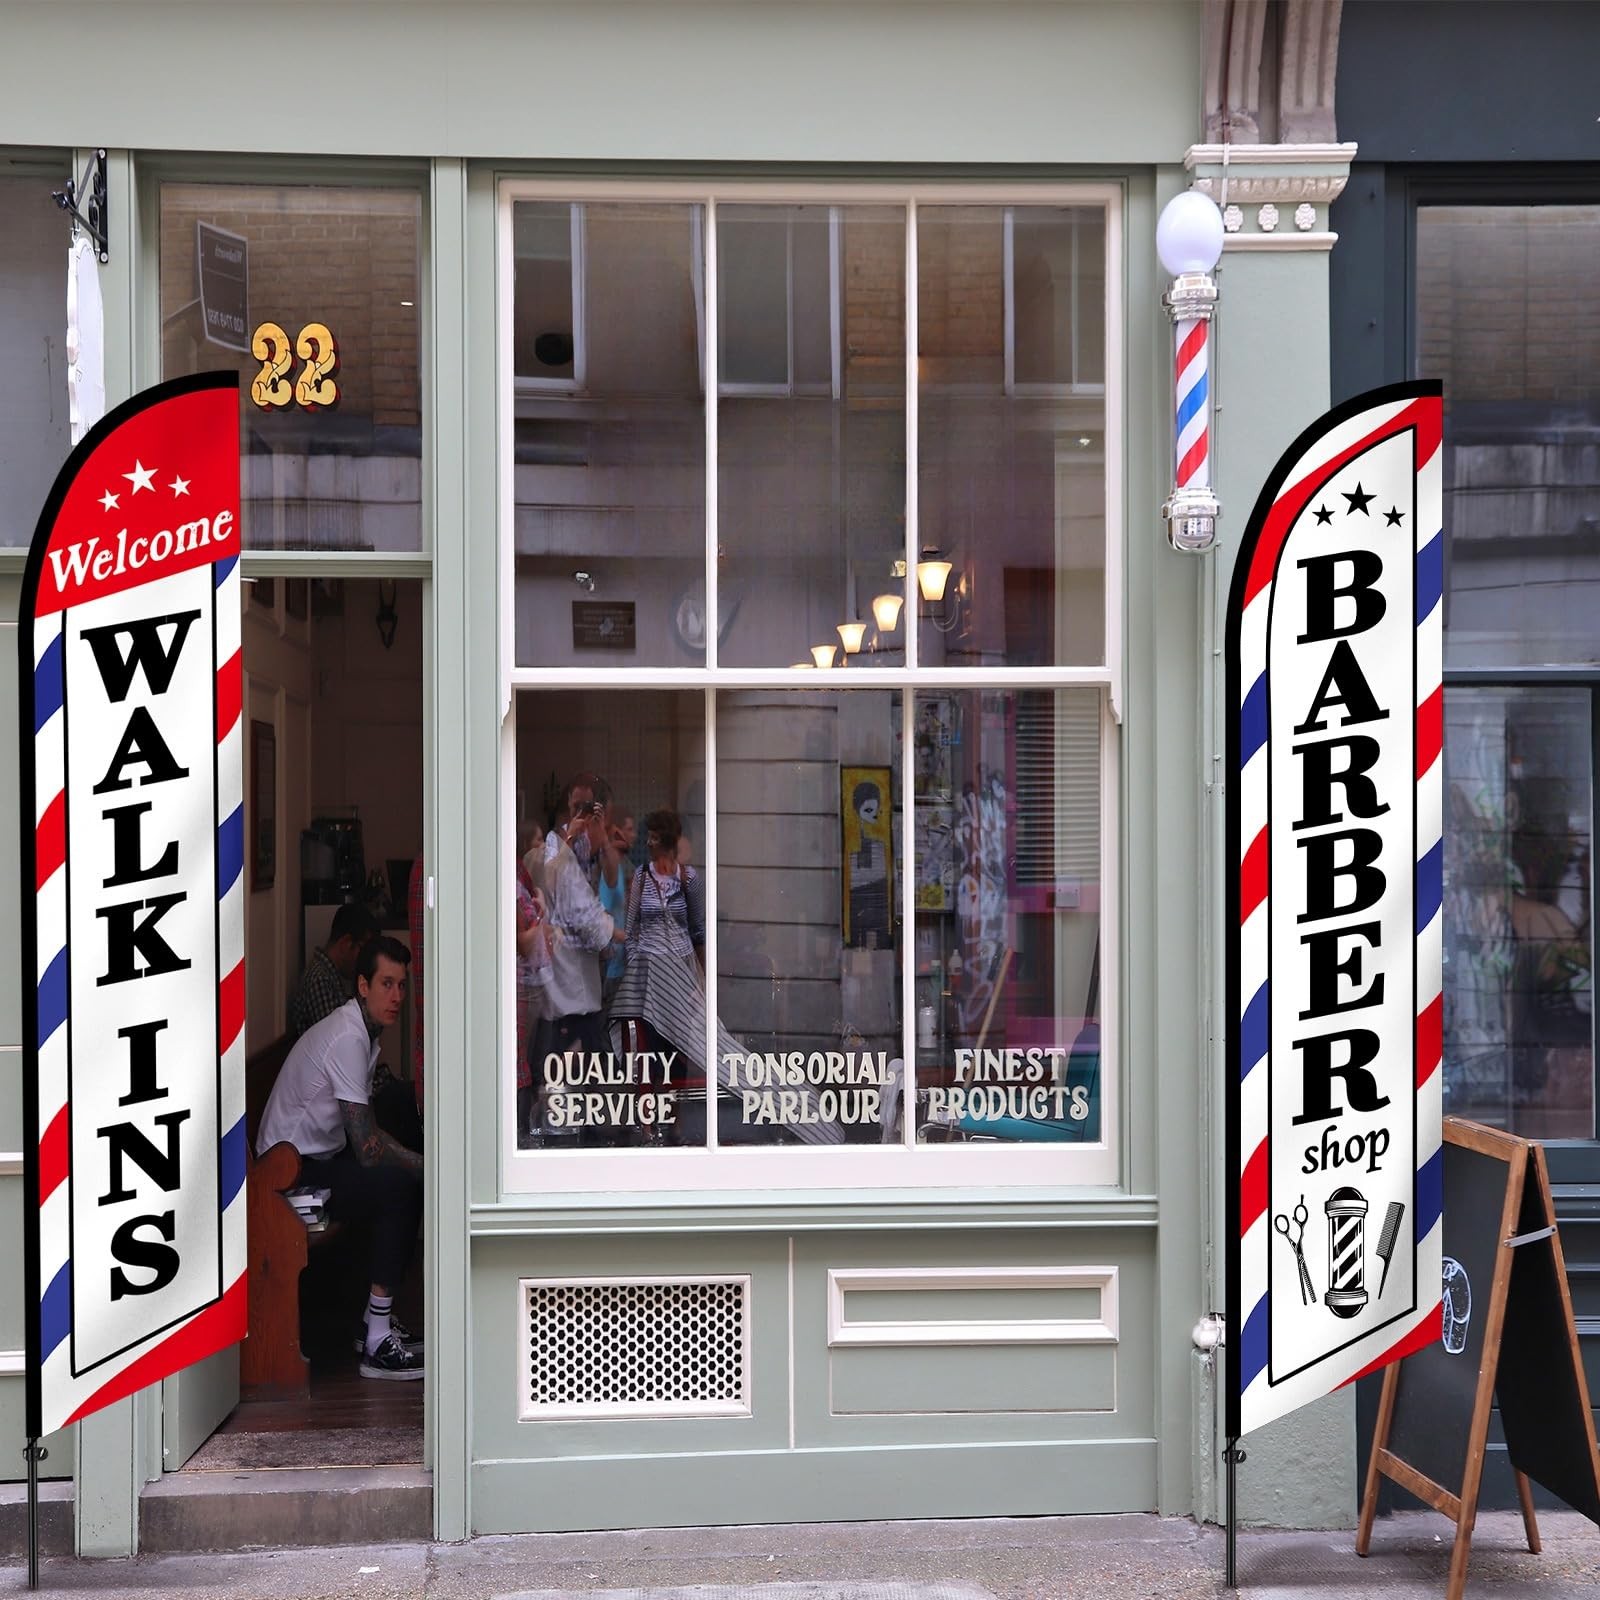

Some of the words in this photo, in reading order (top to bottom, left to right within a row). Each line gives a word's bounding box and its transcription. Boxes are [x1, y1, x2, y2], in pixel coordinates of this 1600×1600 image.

[250, 322, 338, 409] 22
[49, 511, 233, 592] Welcome
[80, 609, 201, 986] WALK
[1293, 550, 1390, 1126] BARBER
[543, 1051, 678, 1092] QUALITY
[722, 1051, 896, 1087] TONSORIAL
[953, 1047, 1067, 1082] FINEST
[547, 1089, 677, 1127] SERVICE
[742, 1088, 881, 1126] PARLOUR
[927, 1085, 1089, 1121] PRODUCTS
[97, 1019, 191, 1301] INS
[1301, 1124, 1390, 1174] shop
